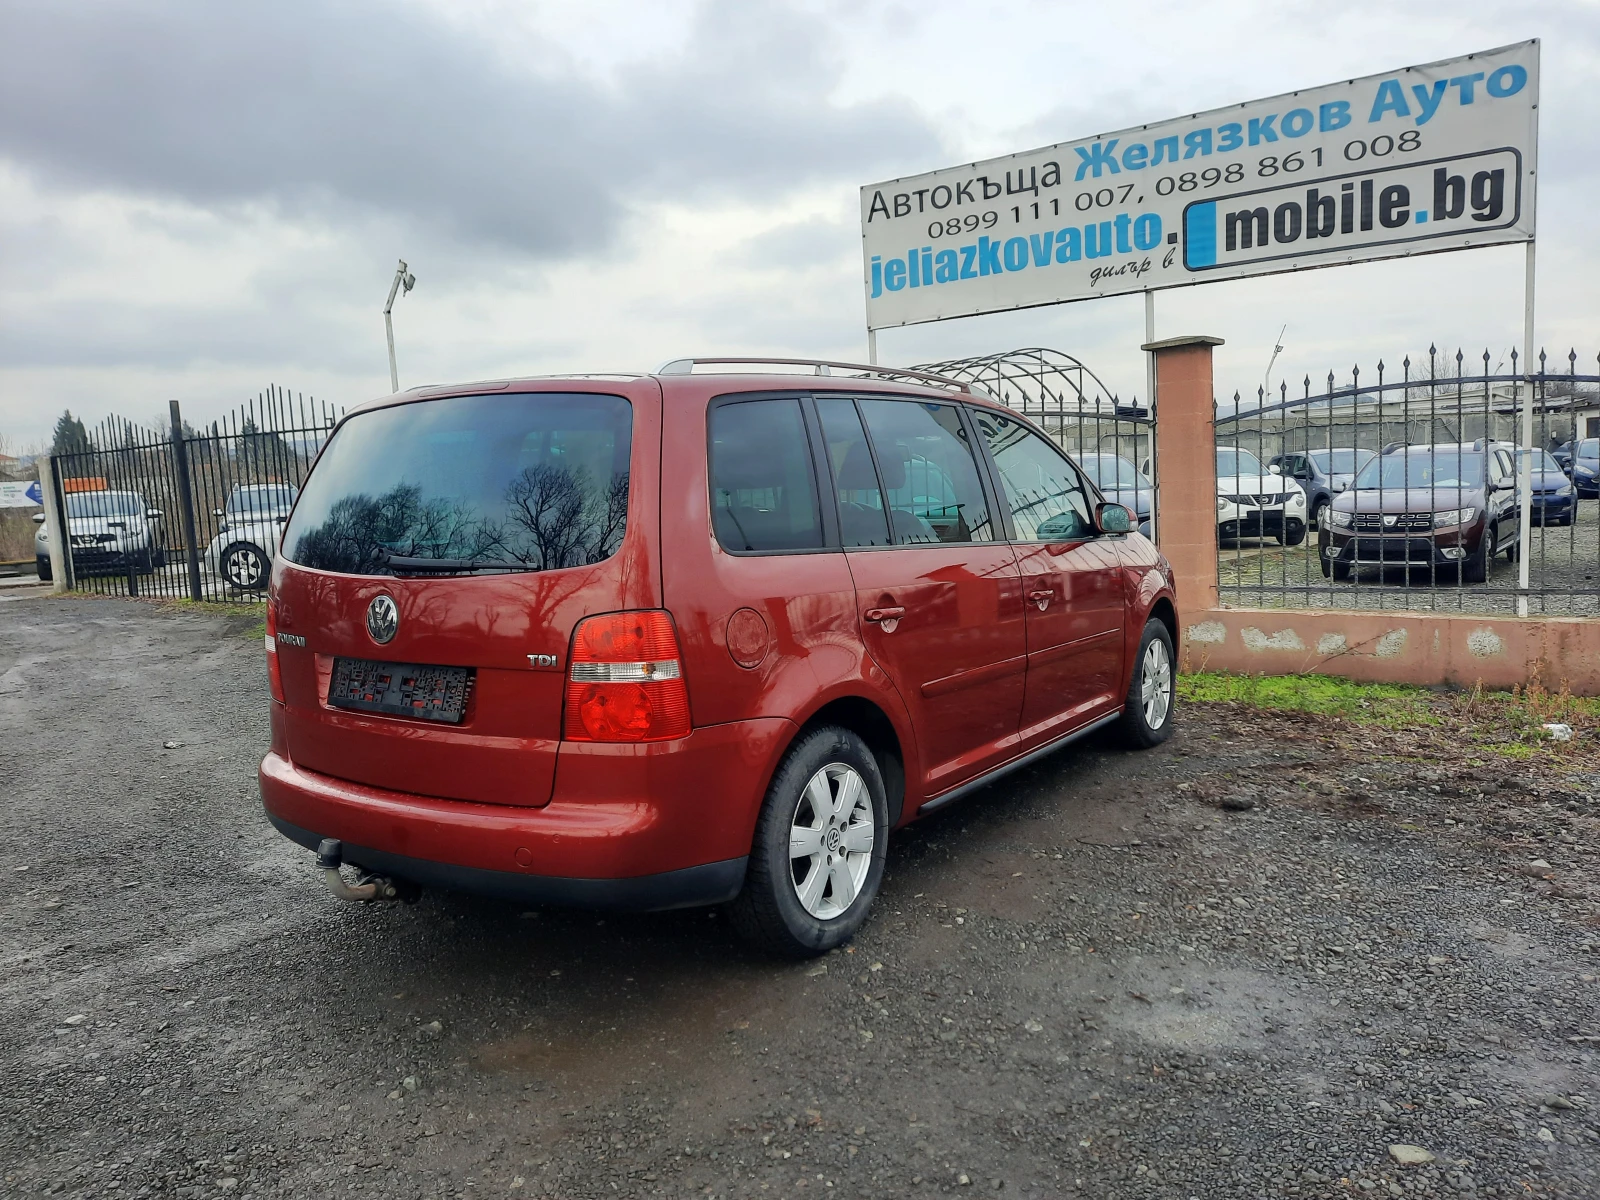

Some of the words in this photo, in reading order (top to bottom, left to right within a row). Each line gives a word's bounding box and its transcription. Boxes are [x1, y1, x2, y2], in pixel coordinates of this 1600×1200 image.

[867, 161, 1061, 223] Автокъща
[1073, 100, 1352, 182] Желязков
[1367, 64, 1528, 126] Ауто
[927, 210, 999, 239] 0899
[1010, 198, 1060, 223] 111
[1074, 183, 1144, 212] 007,
[1155, 163, 1245, 196] 0898
[1257, 147, 1323, 177] 861
[1343, 130, 1422, 161] 008
[1225, 167, 1505, 251] mobile.bg
[1090, 256, 1152, 287] дилър
[526, 654, 557, 667] TDI
